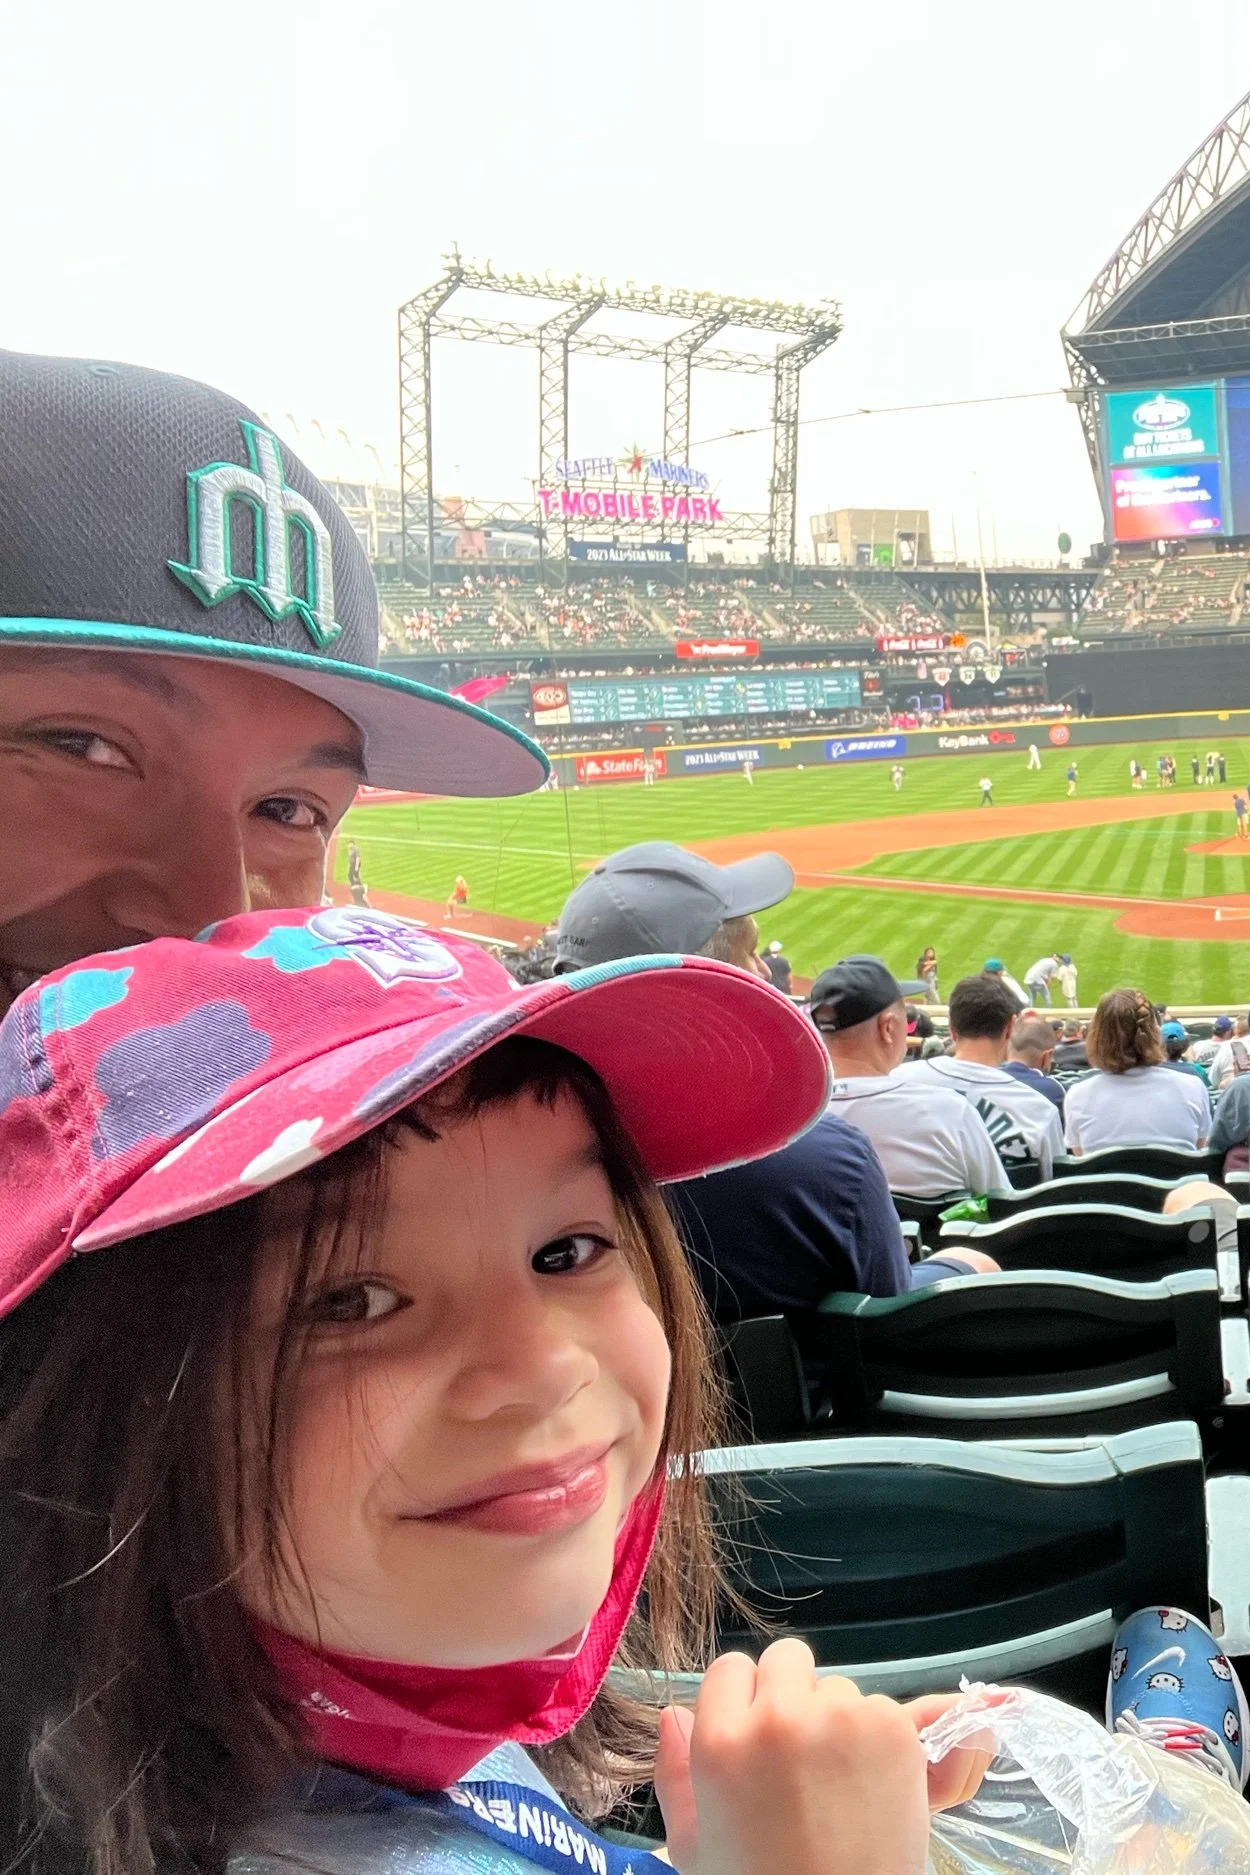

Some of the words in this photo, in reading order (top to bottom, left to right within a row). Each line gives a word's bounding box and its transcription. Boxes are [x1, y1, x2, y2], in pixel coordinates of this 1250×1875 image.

[555, 457, 614, 481] SEATTLE
[649, 459, 709, 489] MARINERS
[538, 488, 656, 519] T-MOBILE
[661, 496, 723, 521] PARK
[587, 548, 608, 561] 2023
[938, 735, 989, 749] KeyBank
[603, 759, 632, 774] State
[685, 754, 703, 766] 2023
[449, 1786, 608, 1875] MARINERS
